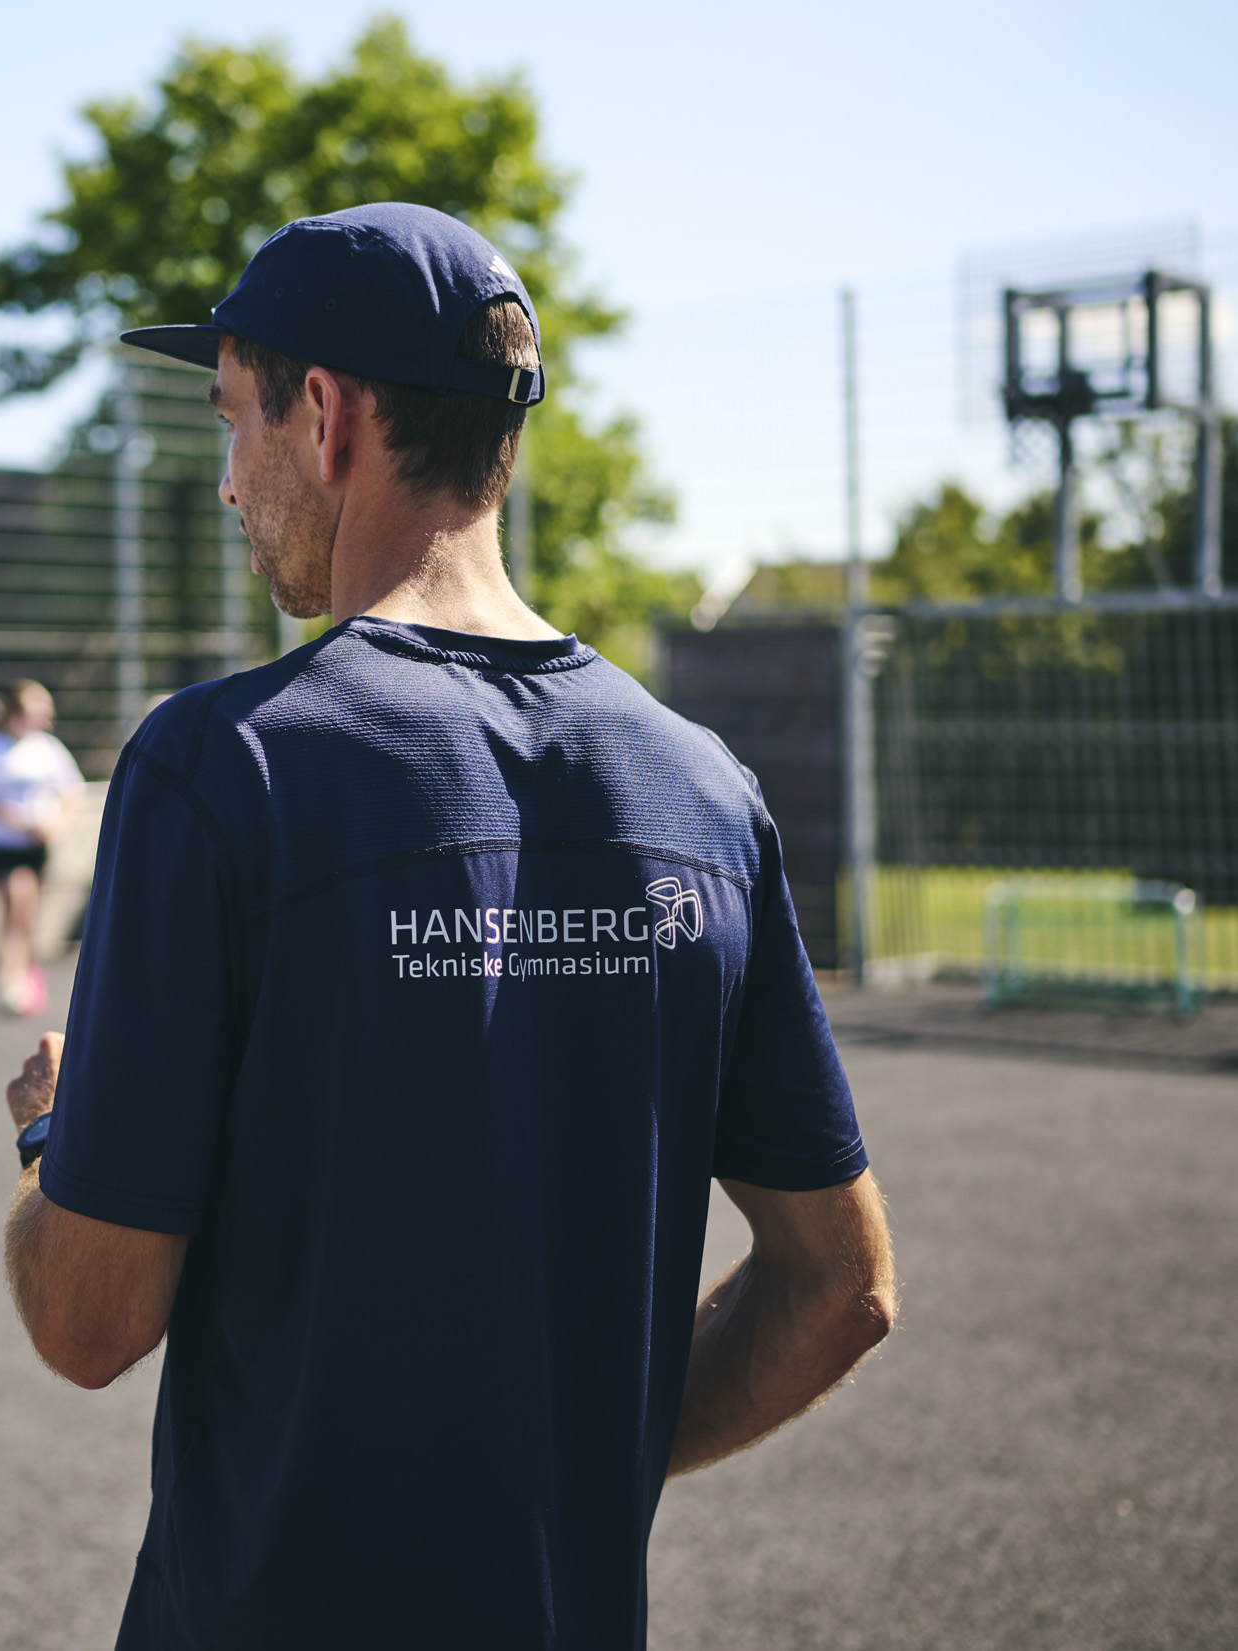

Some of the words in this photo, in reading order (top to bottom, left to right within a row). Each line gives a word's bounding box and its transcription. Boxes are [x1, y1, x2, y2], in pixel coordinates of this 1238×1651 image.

[390, 907, 650, 944] HANSENBERG
[392, 952, 503, 978] Tekniske
[508, 951, 650, 982] Gymnasium
